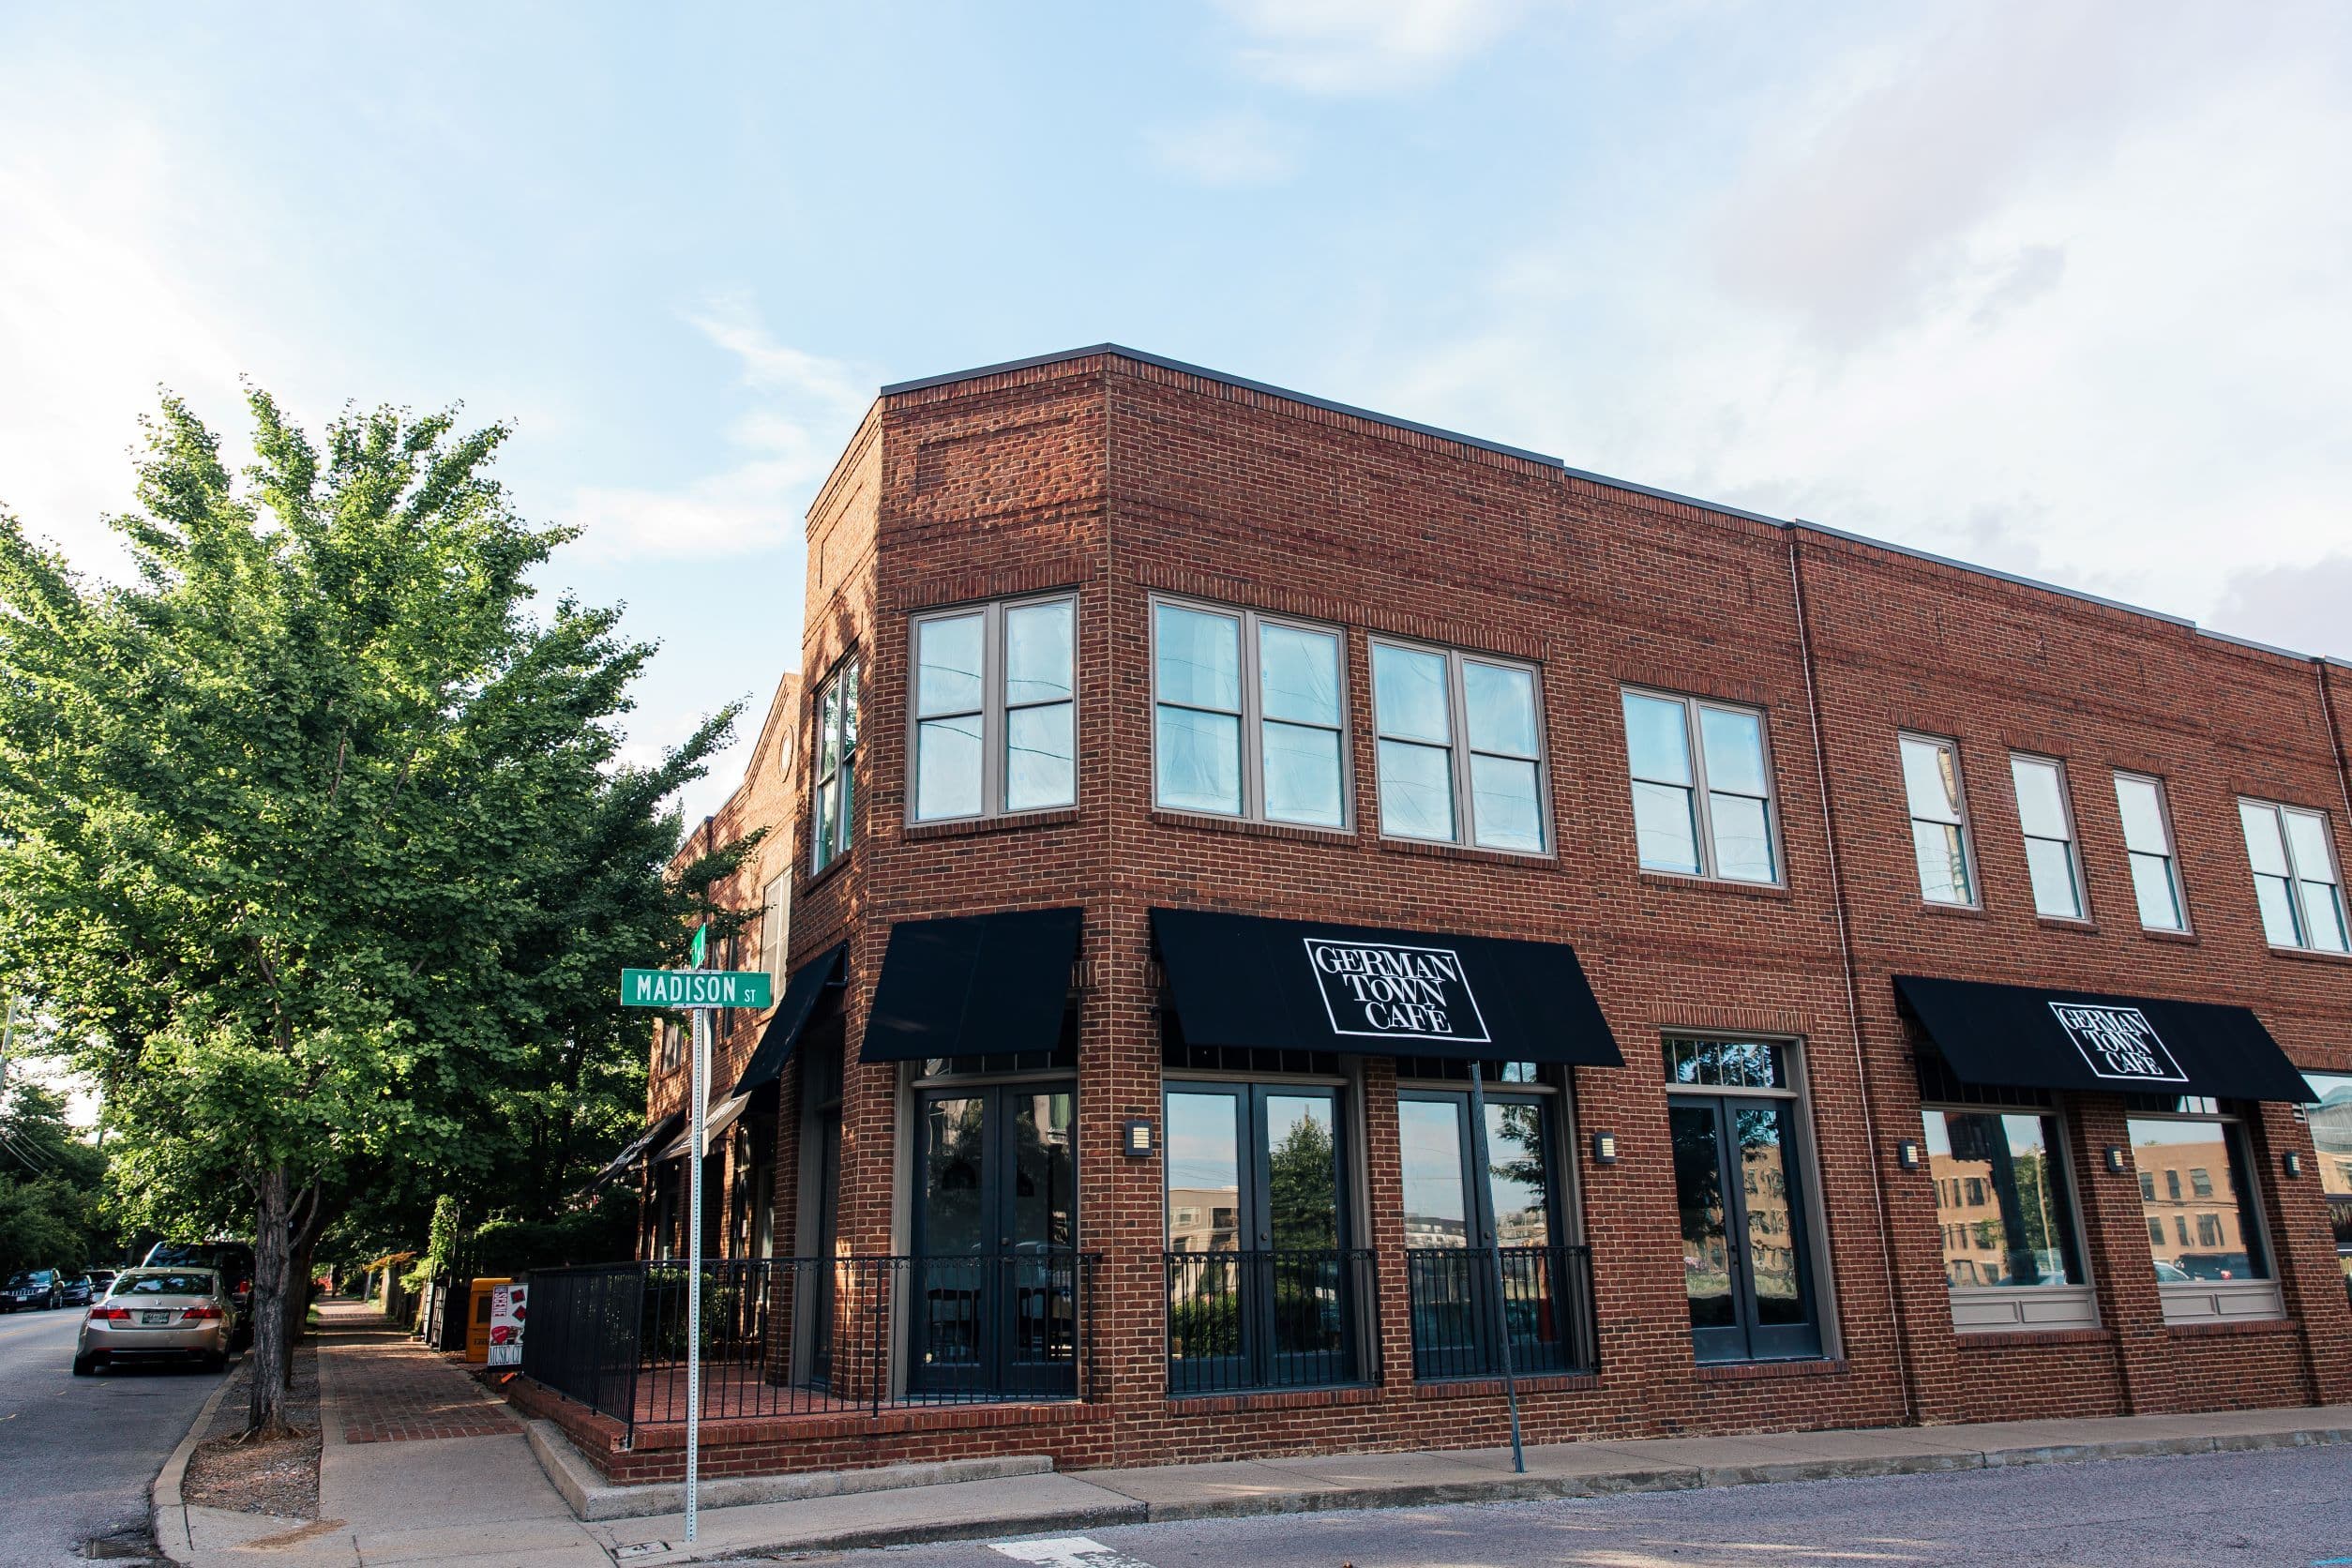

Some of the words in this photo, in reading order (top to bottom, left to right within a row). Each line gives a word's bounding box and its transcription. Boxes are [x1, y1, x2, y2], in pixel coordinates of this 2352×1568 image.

[1315, 945, 1457, 982] GERMAN
[637, 974, 736, 1003] MADISON
[745, 988, 757, 1003] ST
[1342, 973, 1447, 1007] TOWN
[2058, 1007, 2150, 1034] GERMAN
[2081, 1030, 2152, 1055] TOWN
[489, 1346, 510, 1365] MUSIC
